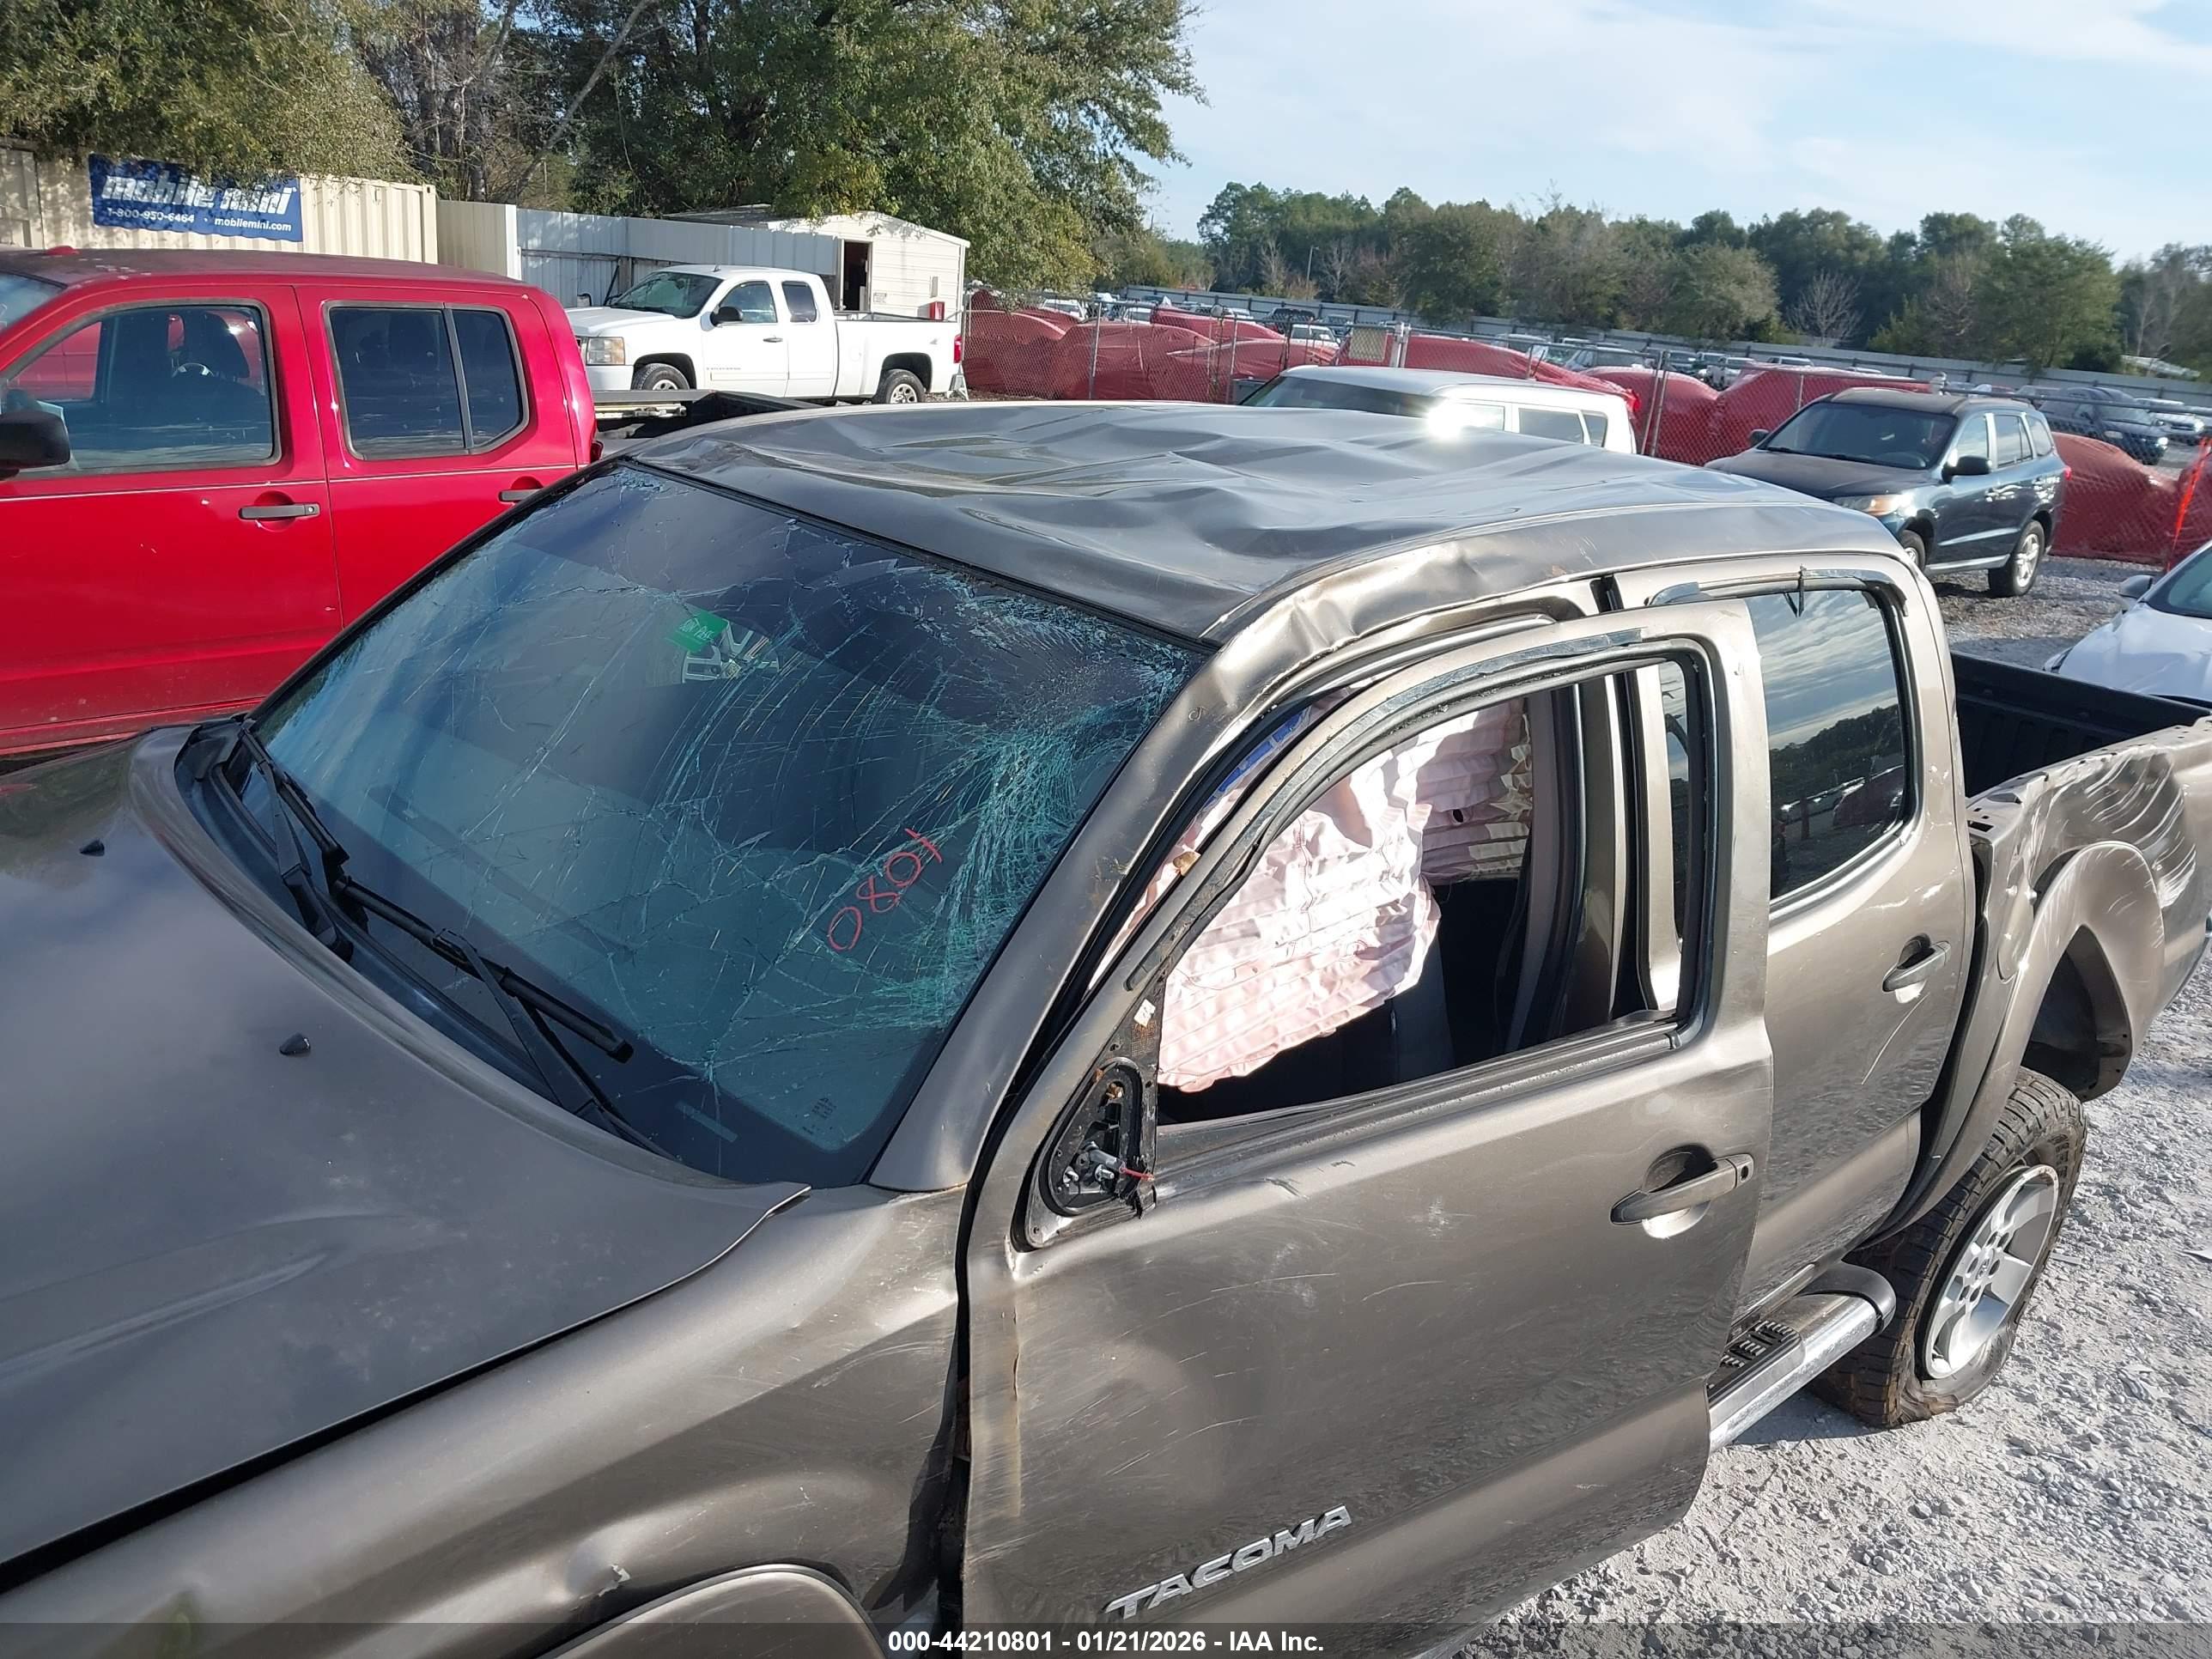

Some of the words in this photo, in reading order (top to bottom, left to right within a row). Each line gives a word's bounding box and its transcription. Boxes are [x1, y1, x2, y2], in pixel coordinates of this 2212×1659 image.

[100, 171, 216, 208] mobile
[220, 184, 294, 215] mini
[107, 207, 195, 223] 1-800-950-6464
[215, 216, 292, 232] mobilemini.com
[827, 827, 943, 951] 0801
[1103, 1504, 1352, 1620] TACOMA
